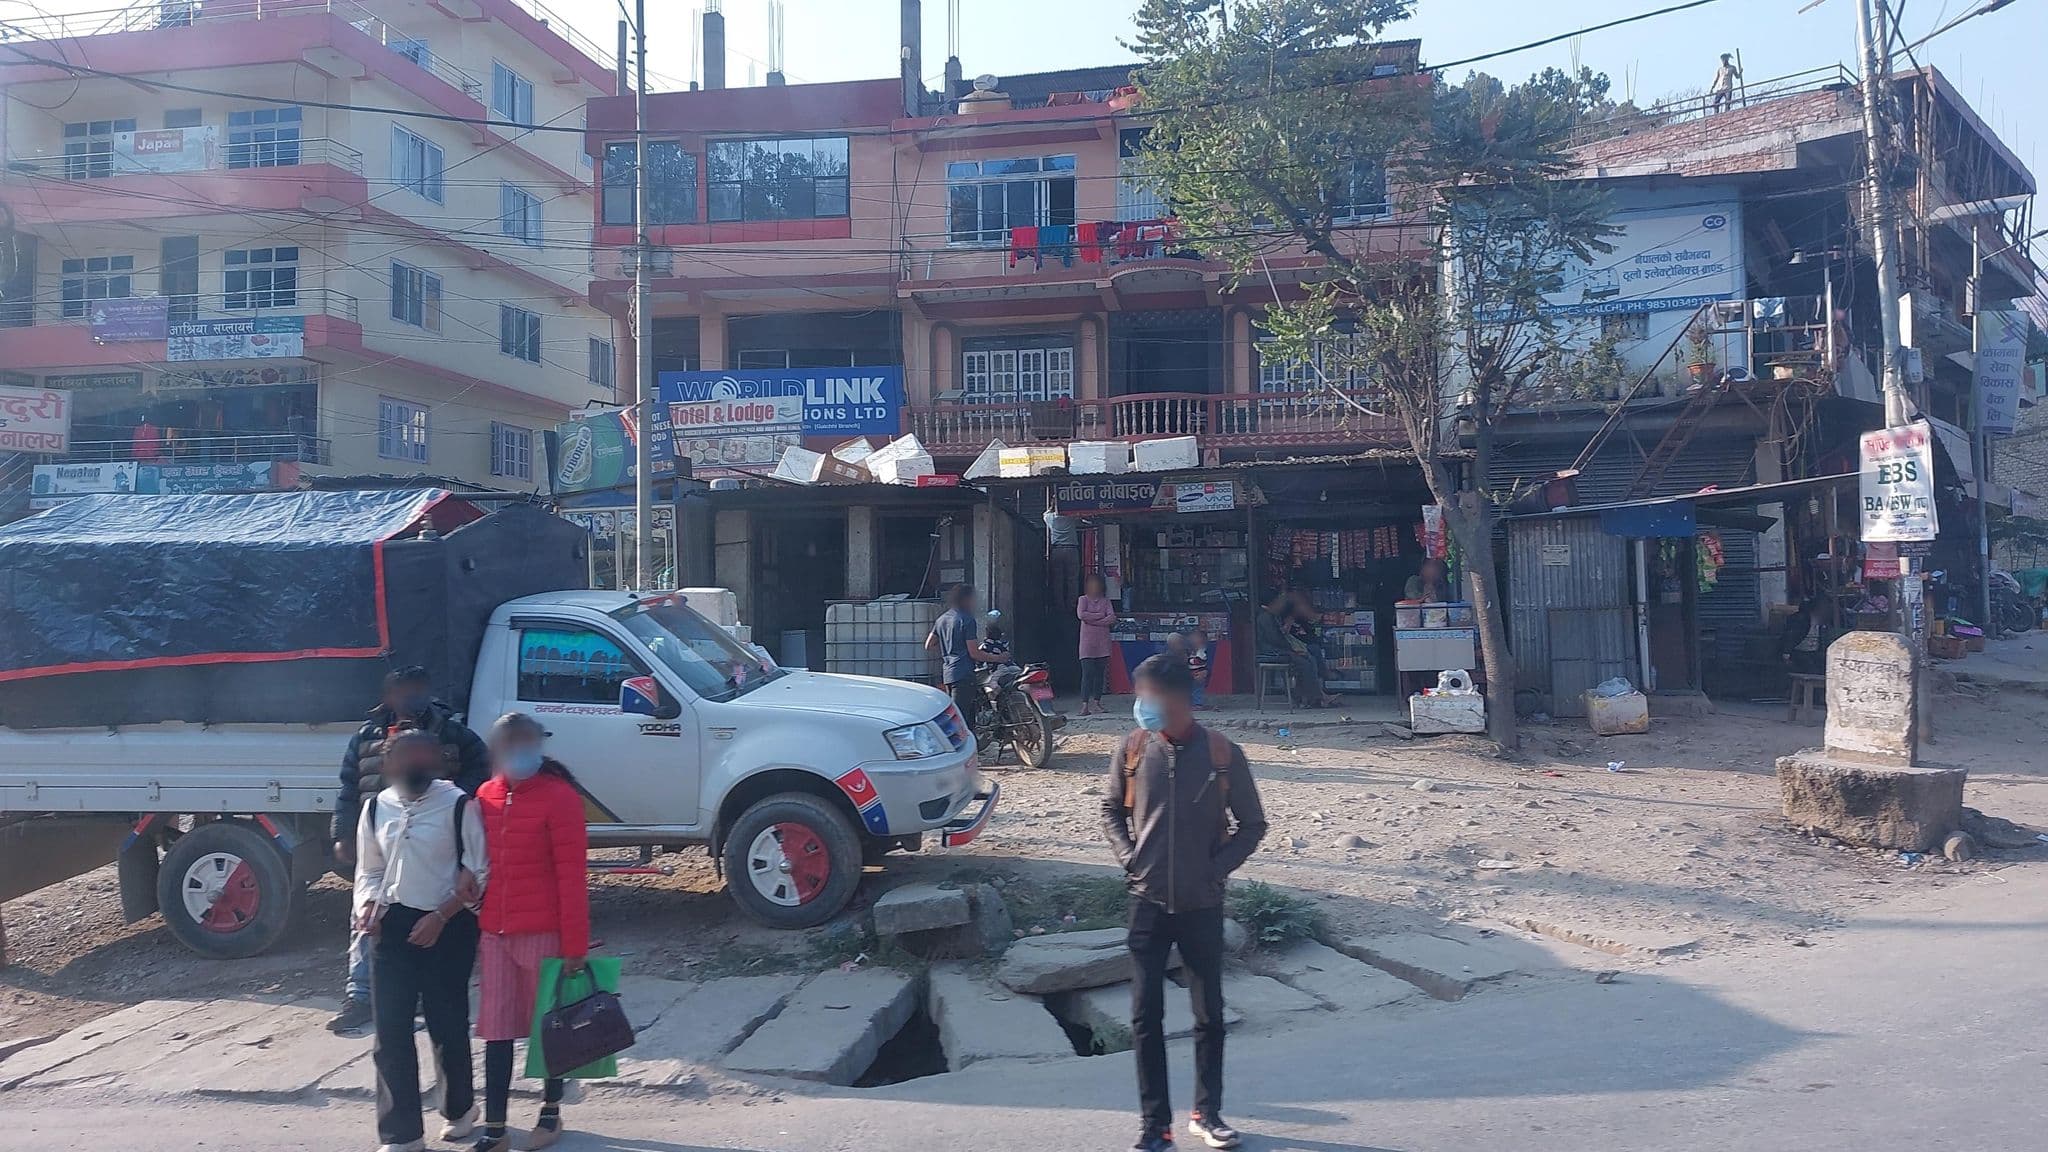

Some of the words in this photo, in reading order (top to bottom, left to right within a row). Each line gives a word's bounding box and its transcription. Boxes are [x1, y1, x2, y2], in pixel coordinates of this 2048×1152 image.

[727, 402, 774, 422] Lodge
[855, 407, 887, 419] LTD
[560, 439, 588, 481] TUBORG
[637, 723, 681, 732] YODHA
